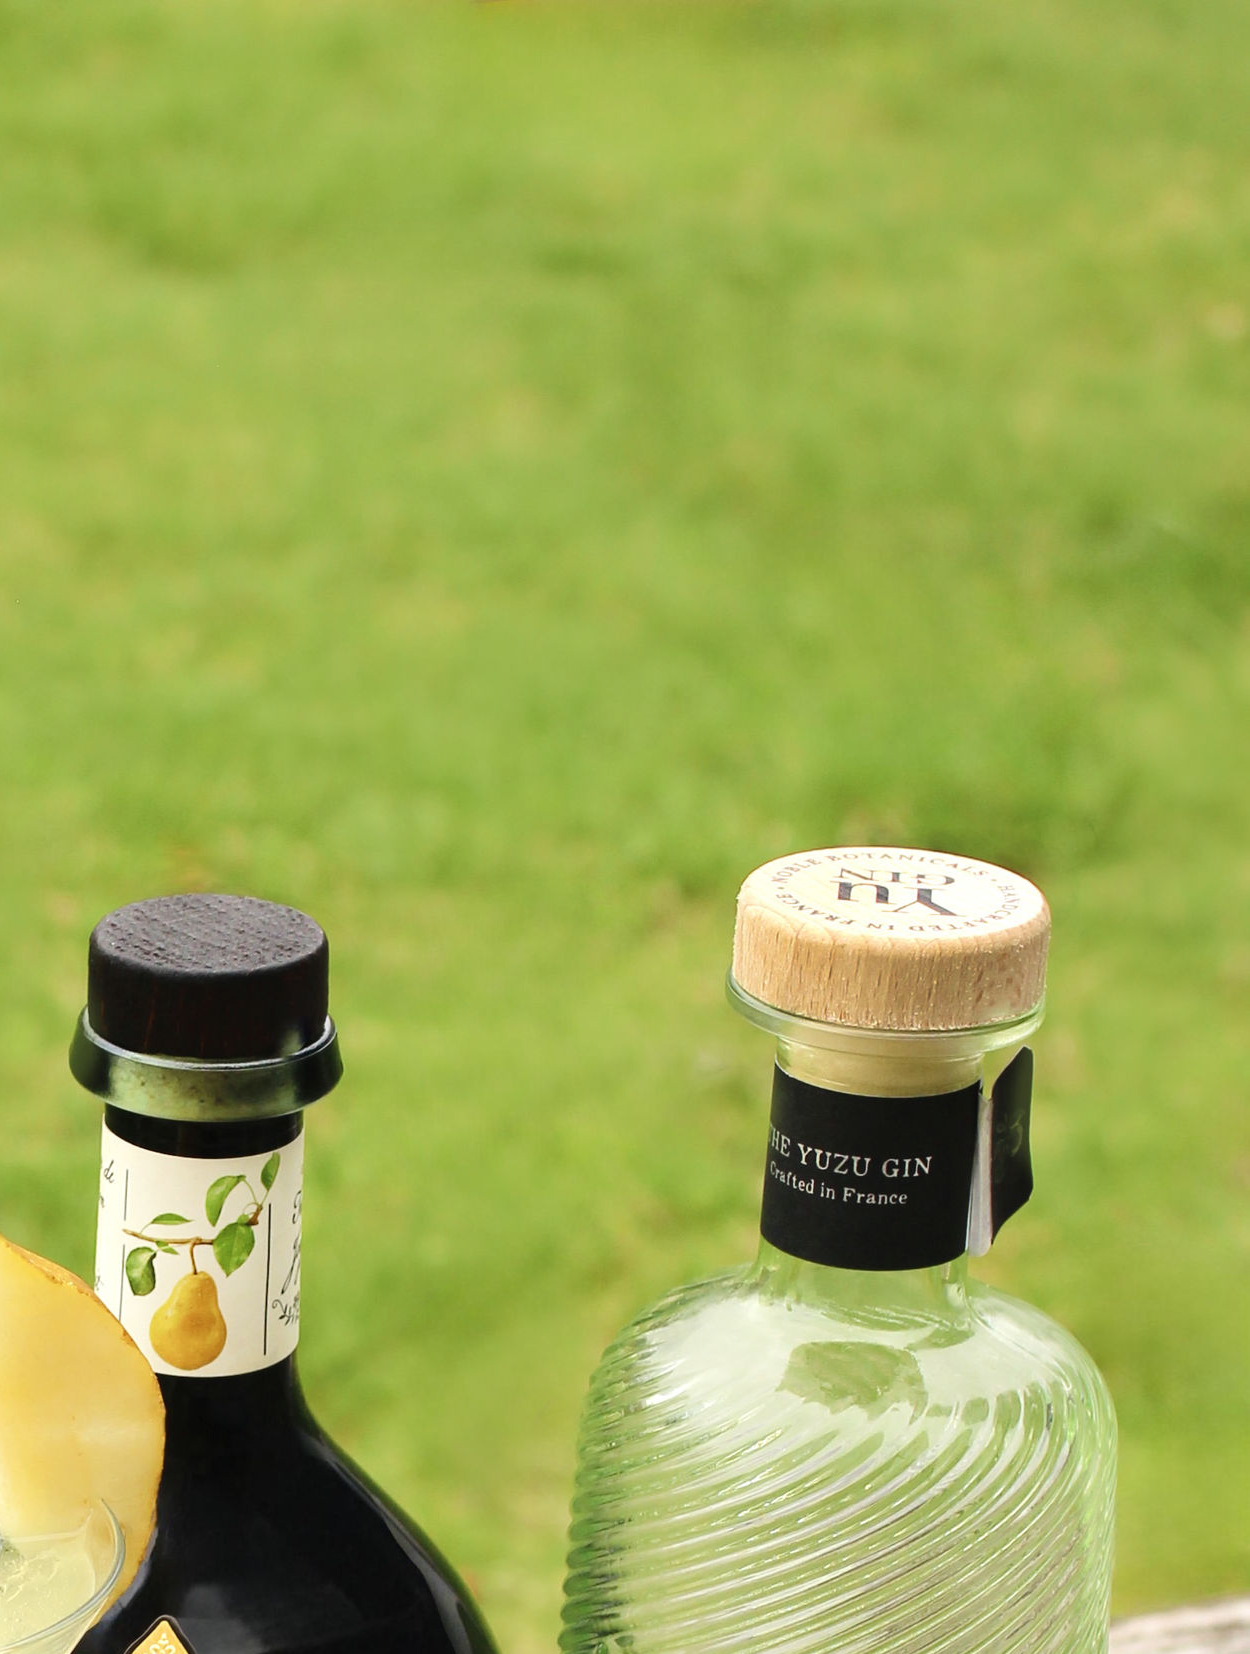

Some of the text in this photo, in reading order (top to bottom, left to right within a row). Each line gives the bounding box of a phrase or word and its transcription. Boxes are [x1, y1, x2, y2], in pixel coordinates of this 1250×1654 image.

[771, 853, 989, 884] NOBLE BOTANICALS
[833, 868, 955, 886] GIN
[776, 884, 1020, 931] HANDCRAFTED IN FRANCE
[829, 880, 967, 917] Yu
[797, 1143, 871, 1177] YUZU
[882, 1156, 932, 1178] GIN
[770, 1160, 908, 1205] Crafted in France
